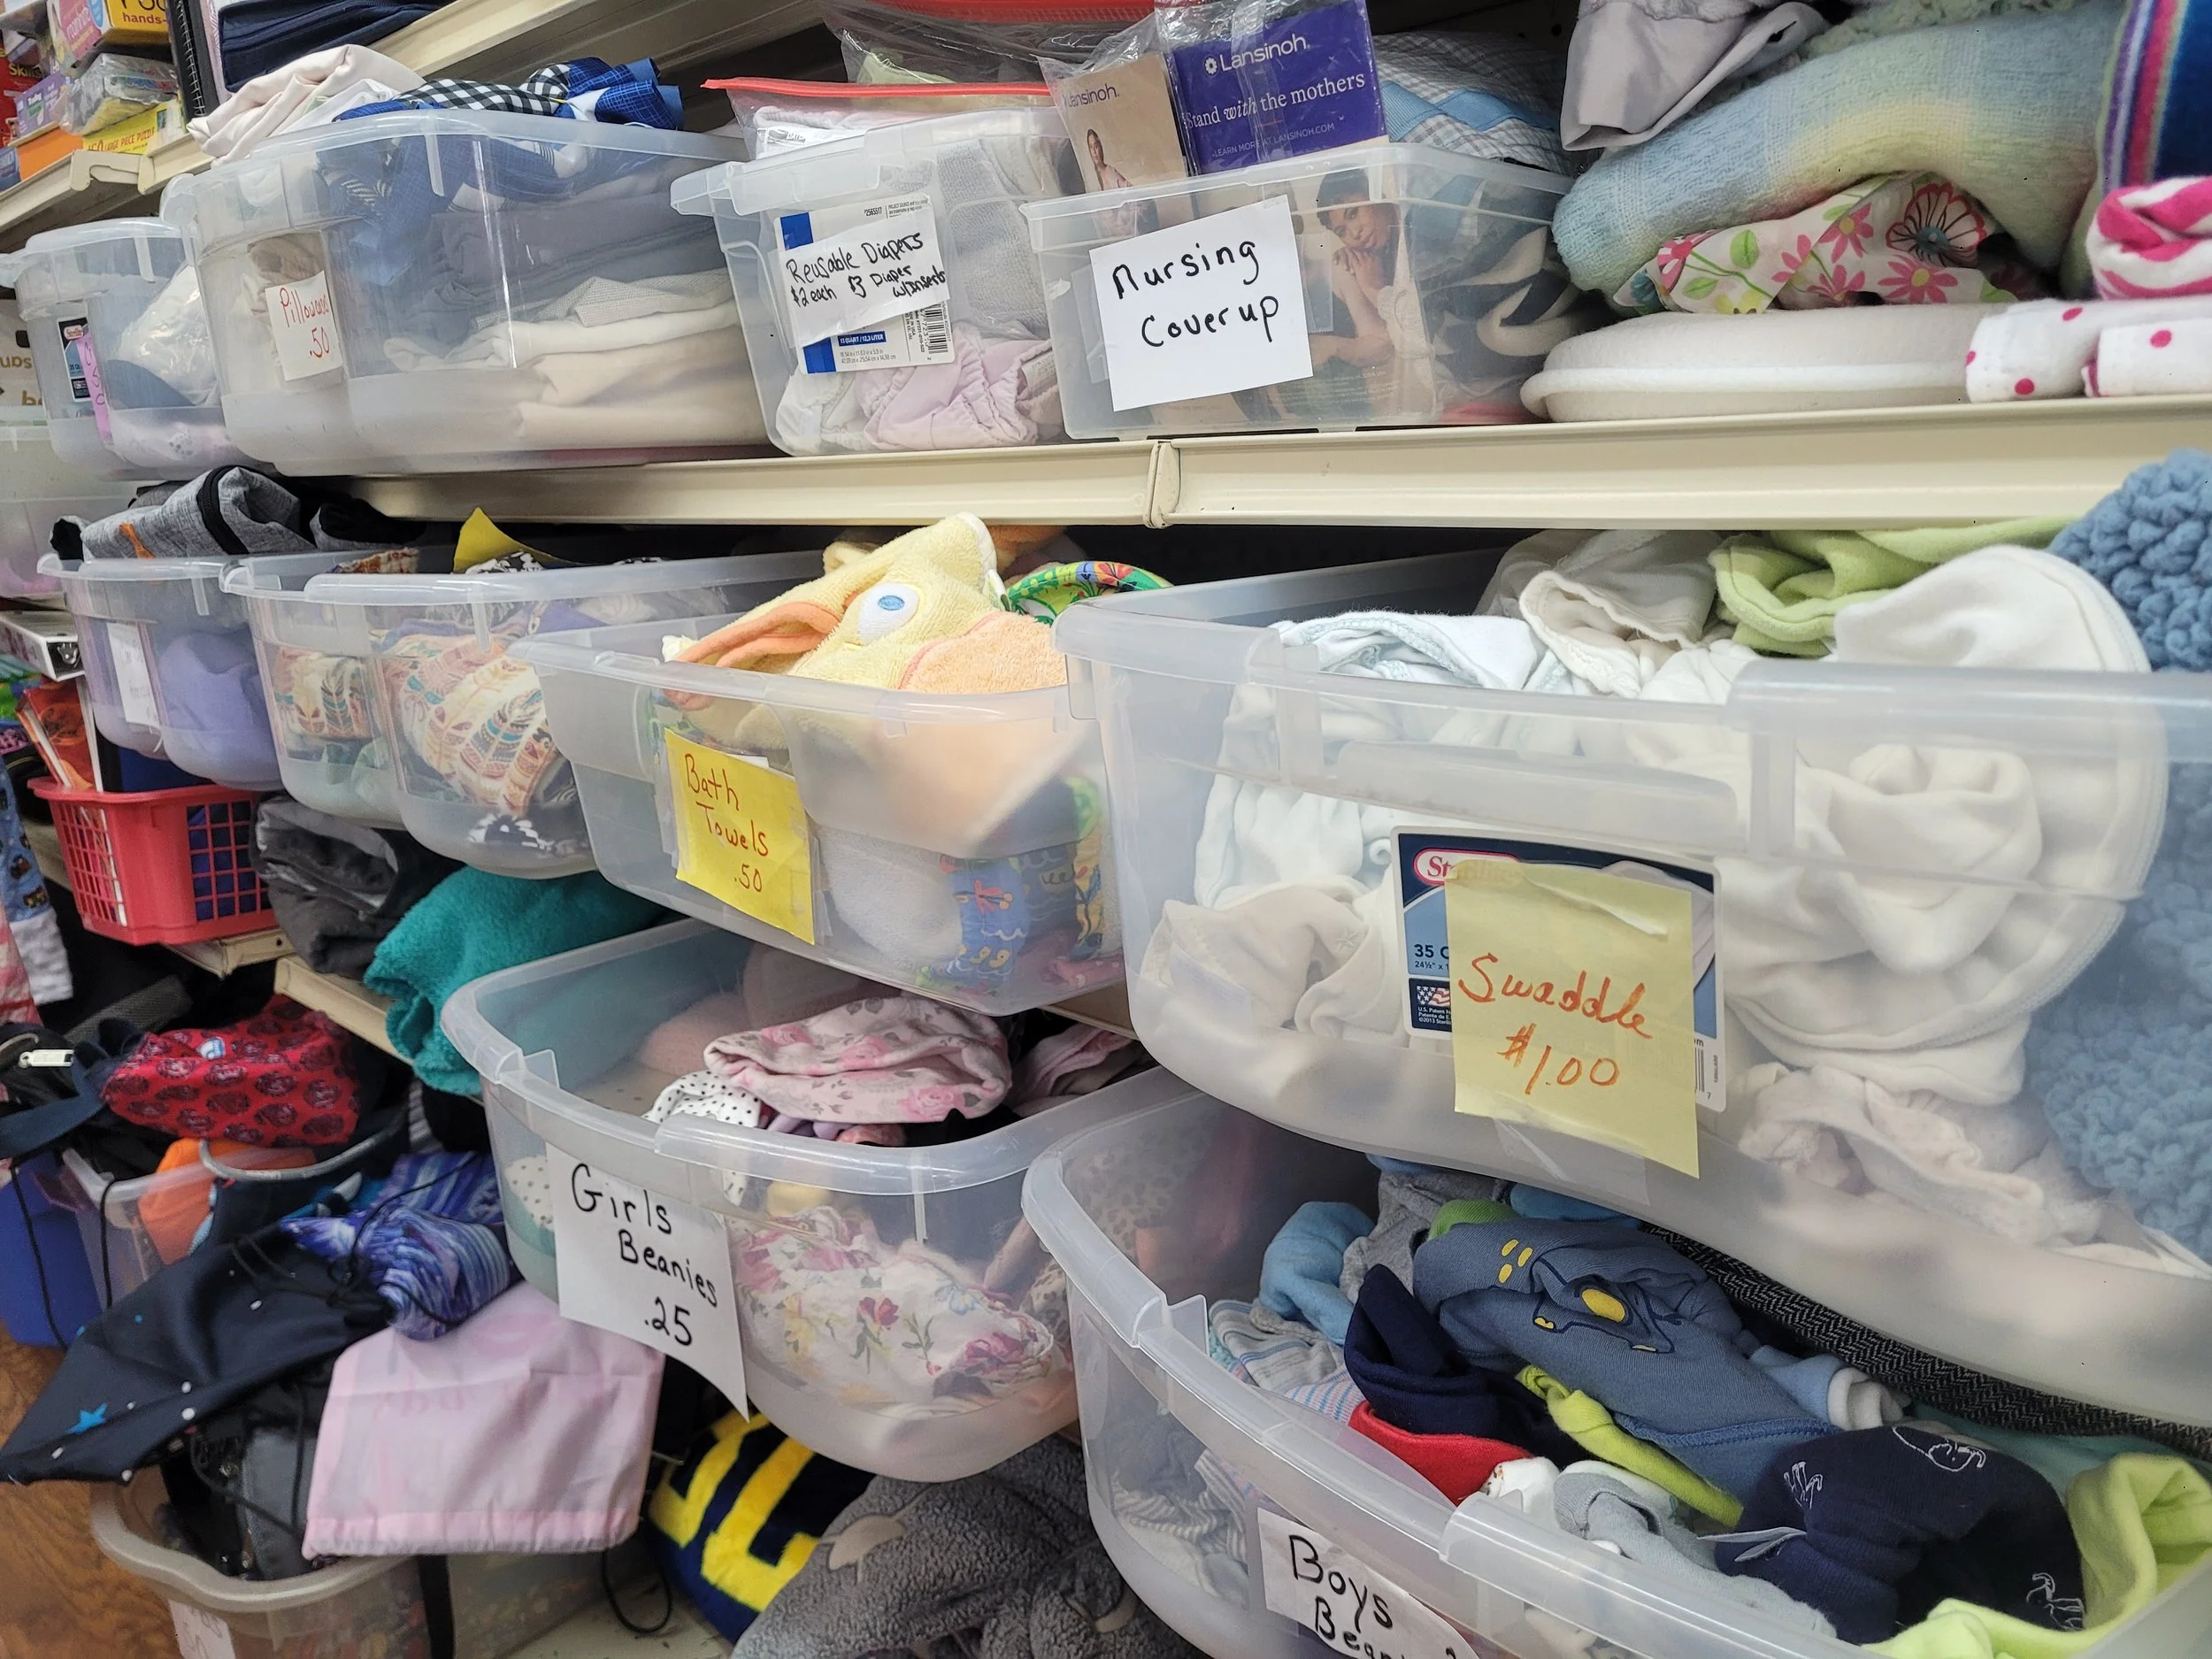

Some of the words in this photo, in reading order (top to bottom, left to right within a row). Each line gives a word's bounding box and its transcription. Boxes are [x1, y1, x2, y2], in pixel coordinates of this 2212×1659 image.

[1219, 34, 1304, 72] Lansinoh
[1186, 106, 1220, 129] Stand
[1224, 98, 1256, 120] with
[1260, 93, 1287, 111] the
[1291, 73, 1365, 104] mothers
[120, 134, 135, 147] PIECE
[136, 127, 155, 142] PUZZLE
[1214, 145, 1238, 157] LEARN
[1239, 140, 1260, 152] MORE
[1263, 137, 1271, 147] AT
[1273, 123, 1335, 143] LANSINOH.COM
[786, 247, 861, 284] Reusable
[861, 233, 924, 264] Diapers
[810, 284, 838, 303] each
[870, 265, 912, 288] Diaper
[1112, 241, 1260, 299] Nursing
[310, 326, 330, 358] .50
[685, 753, 740, 811] Bath
[695, 801, 769, 856] Towels
[734, 864, 763, 893] .50
[1414, 943, 1434, 958] 35
[1458, 952, 1654, 1040] Swaddle
[572, 1163, 672, 1234] Girls
[618, 1229, 718, 1308] Beanies
[644, 1296, 693, 1347] .25
[1289, 1534, 1393, 1634] Boys
